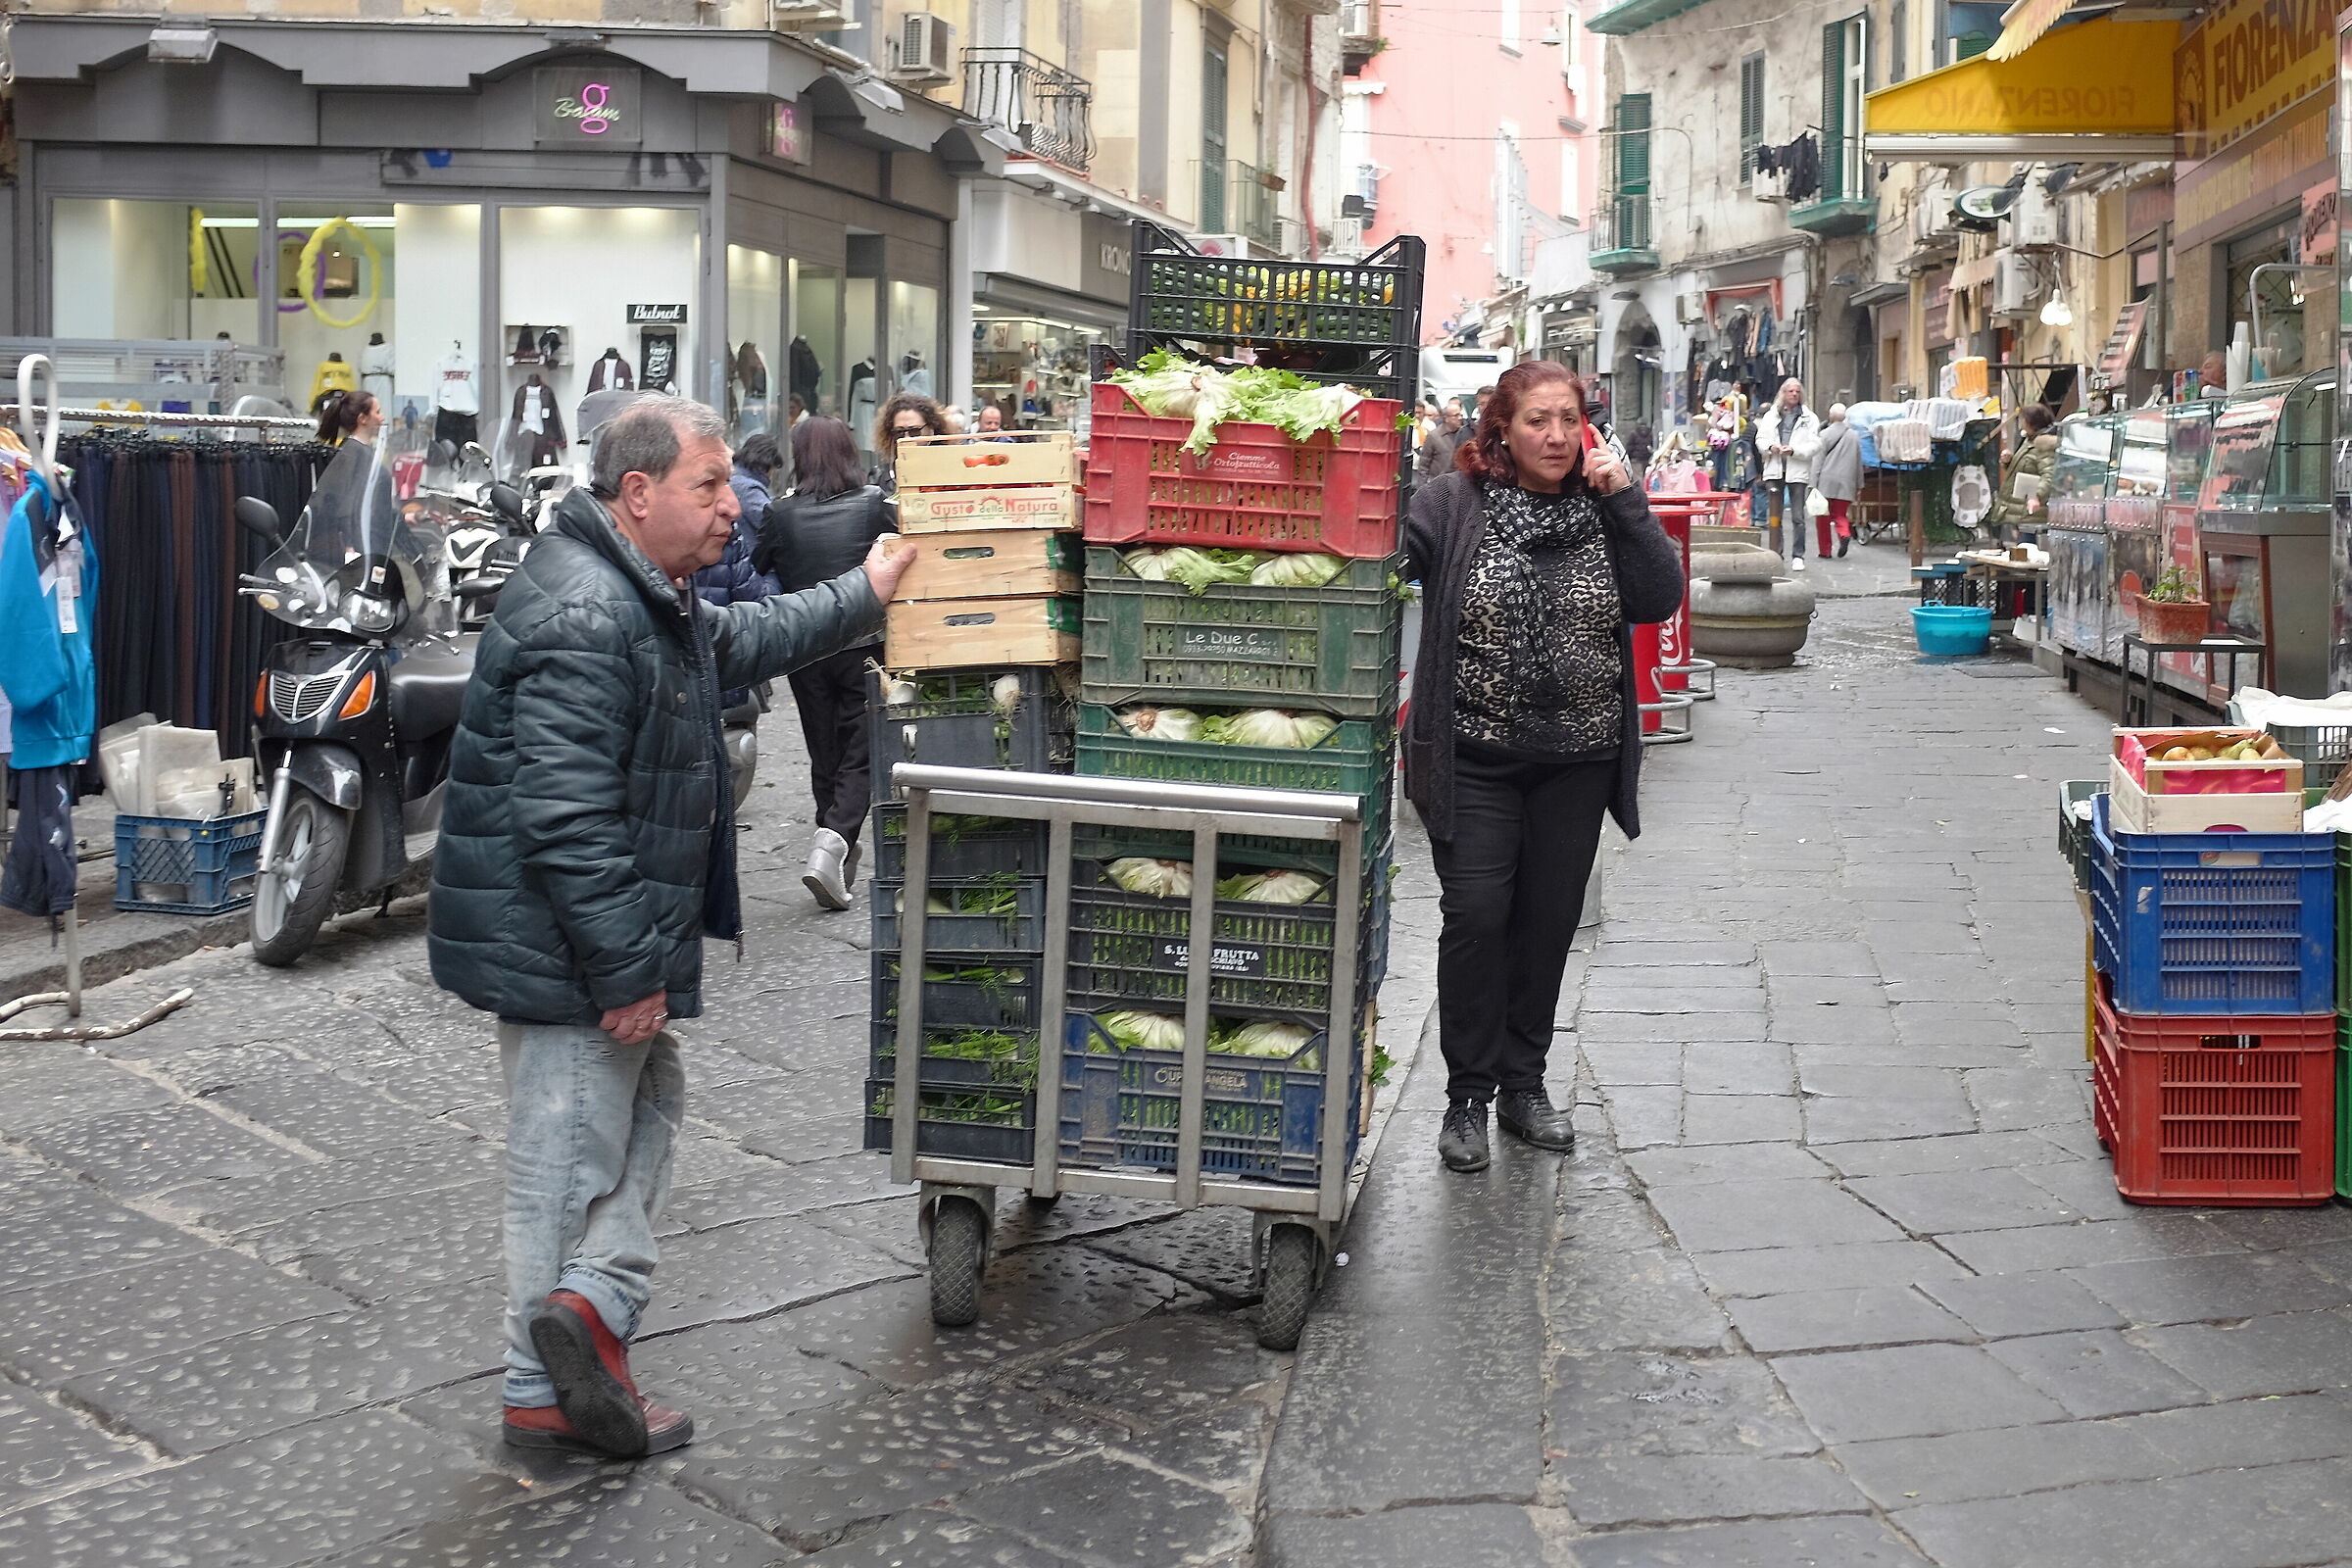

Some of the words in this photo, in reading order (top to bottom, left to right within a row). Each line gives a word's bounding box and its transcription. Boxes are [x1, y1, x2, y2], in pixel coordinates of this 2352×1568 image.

[2213, 0, 2340, 118] FIORENZA
[931, 500, 974, 515] Gusto
[979, 504, 1004, 514] della
[1004, 497, 1058, 514] Natura
[1185, 630, 1205, 644] Le
[1210, 630, 1243, 645] Due
[1247, 632, 1258, 645] C
[1213, 948, 1260, 961] FRUTTA
[1204, 1074, 1249, 1089] ANGELA
